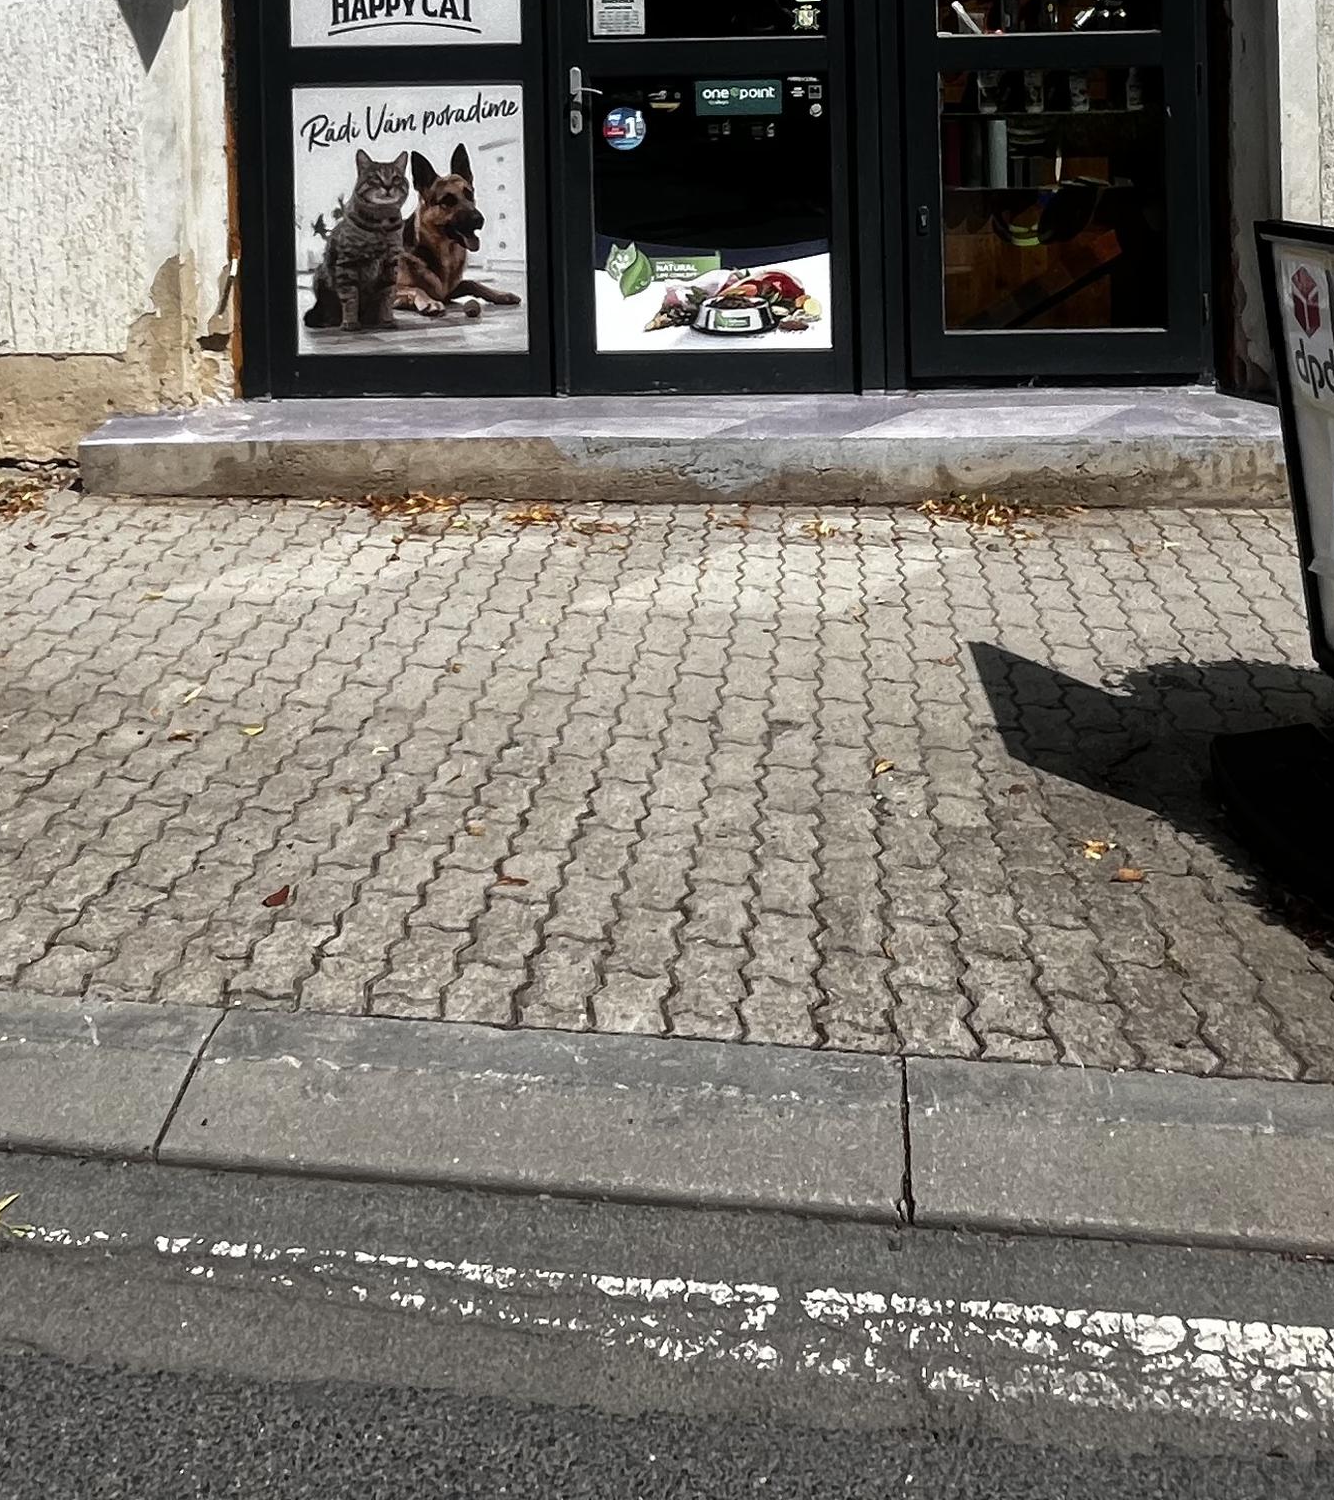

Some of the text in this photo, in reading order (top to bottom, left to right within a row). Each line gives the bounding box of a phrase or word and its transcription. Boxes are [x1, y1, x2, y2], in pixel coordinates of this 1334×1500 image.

[300, 92, 518, 152] Rádi Vám poradíme
